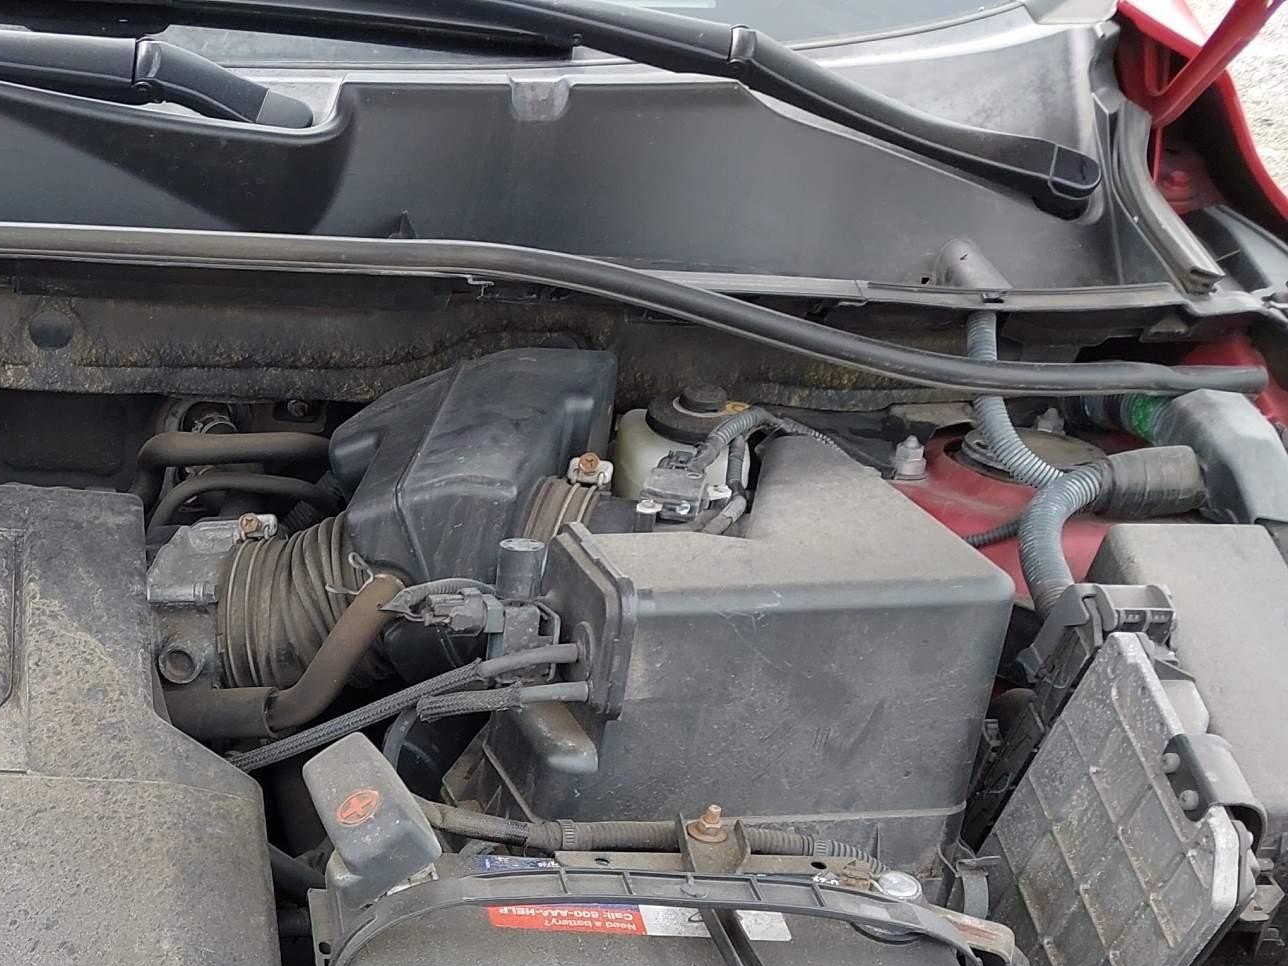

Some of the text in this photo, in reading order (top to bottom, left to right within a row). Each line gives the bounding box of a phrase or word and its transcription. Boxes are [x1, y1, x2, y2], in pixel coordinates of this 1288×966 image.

[603, 911, 633, 921] Call:
[544, 917, 592, 929] battery?
[605, 920, 637, 931] Need
